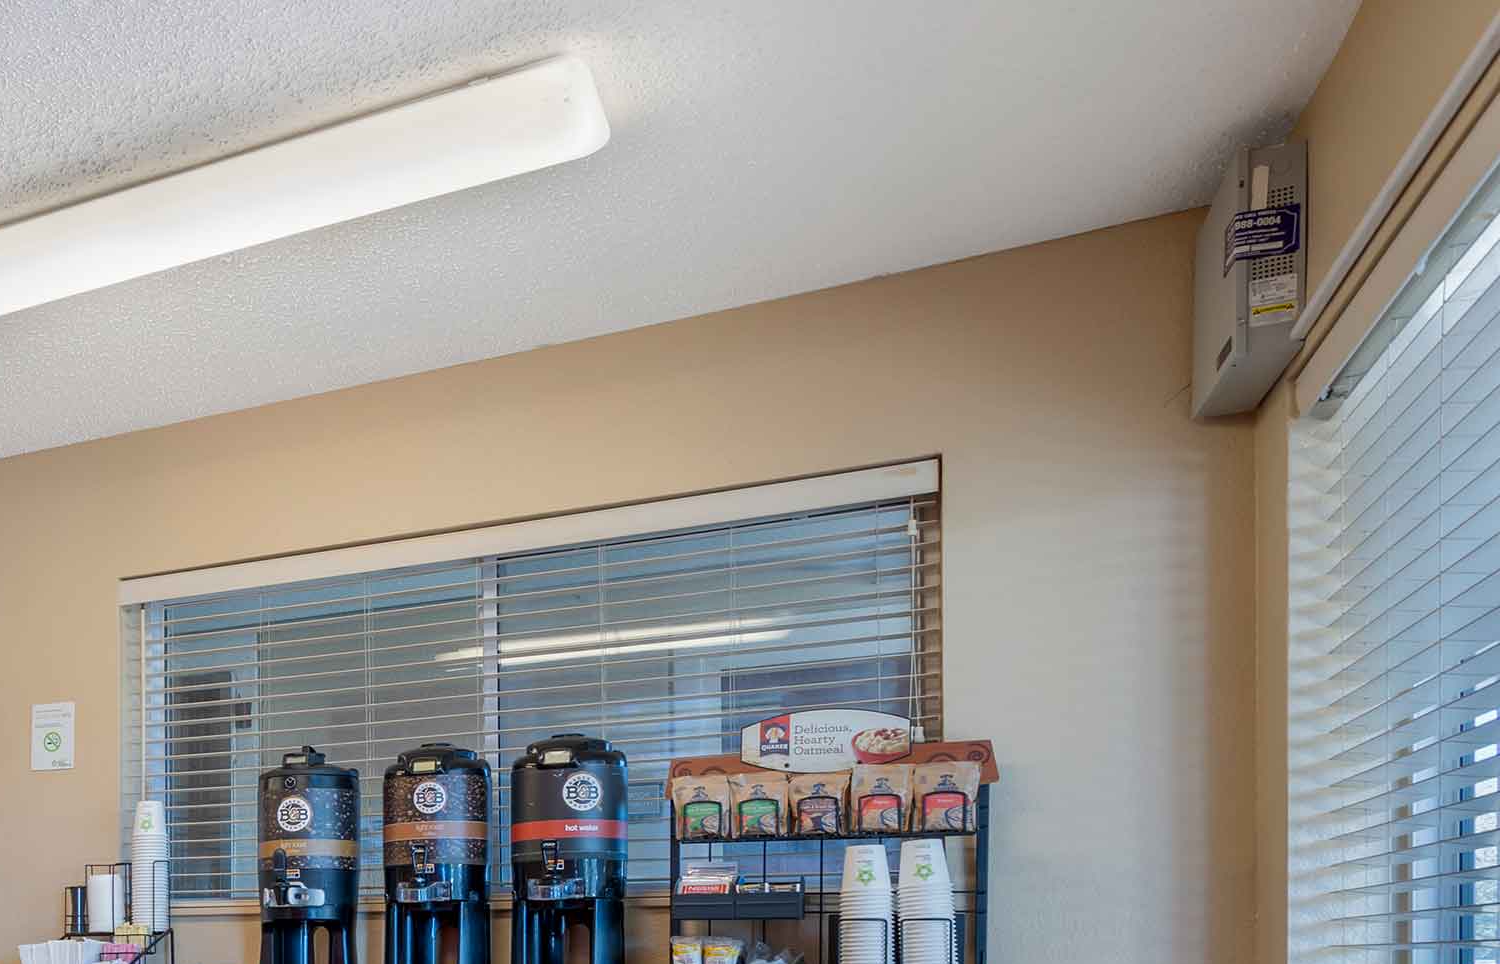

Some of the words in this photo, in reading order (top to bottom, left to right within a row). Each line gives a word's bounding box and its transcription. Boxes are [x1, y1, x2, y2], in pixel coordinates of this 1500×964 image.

[794, 734, 836, 745] Hearty
[761, 743, 789, 751] QUAKER
[794, 744, 844, 755] Oatmeal
